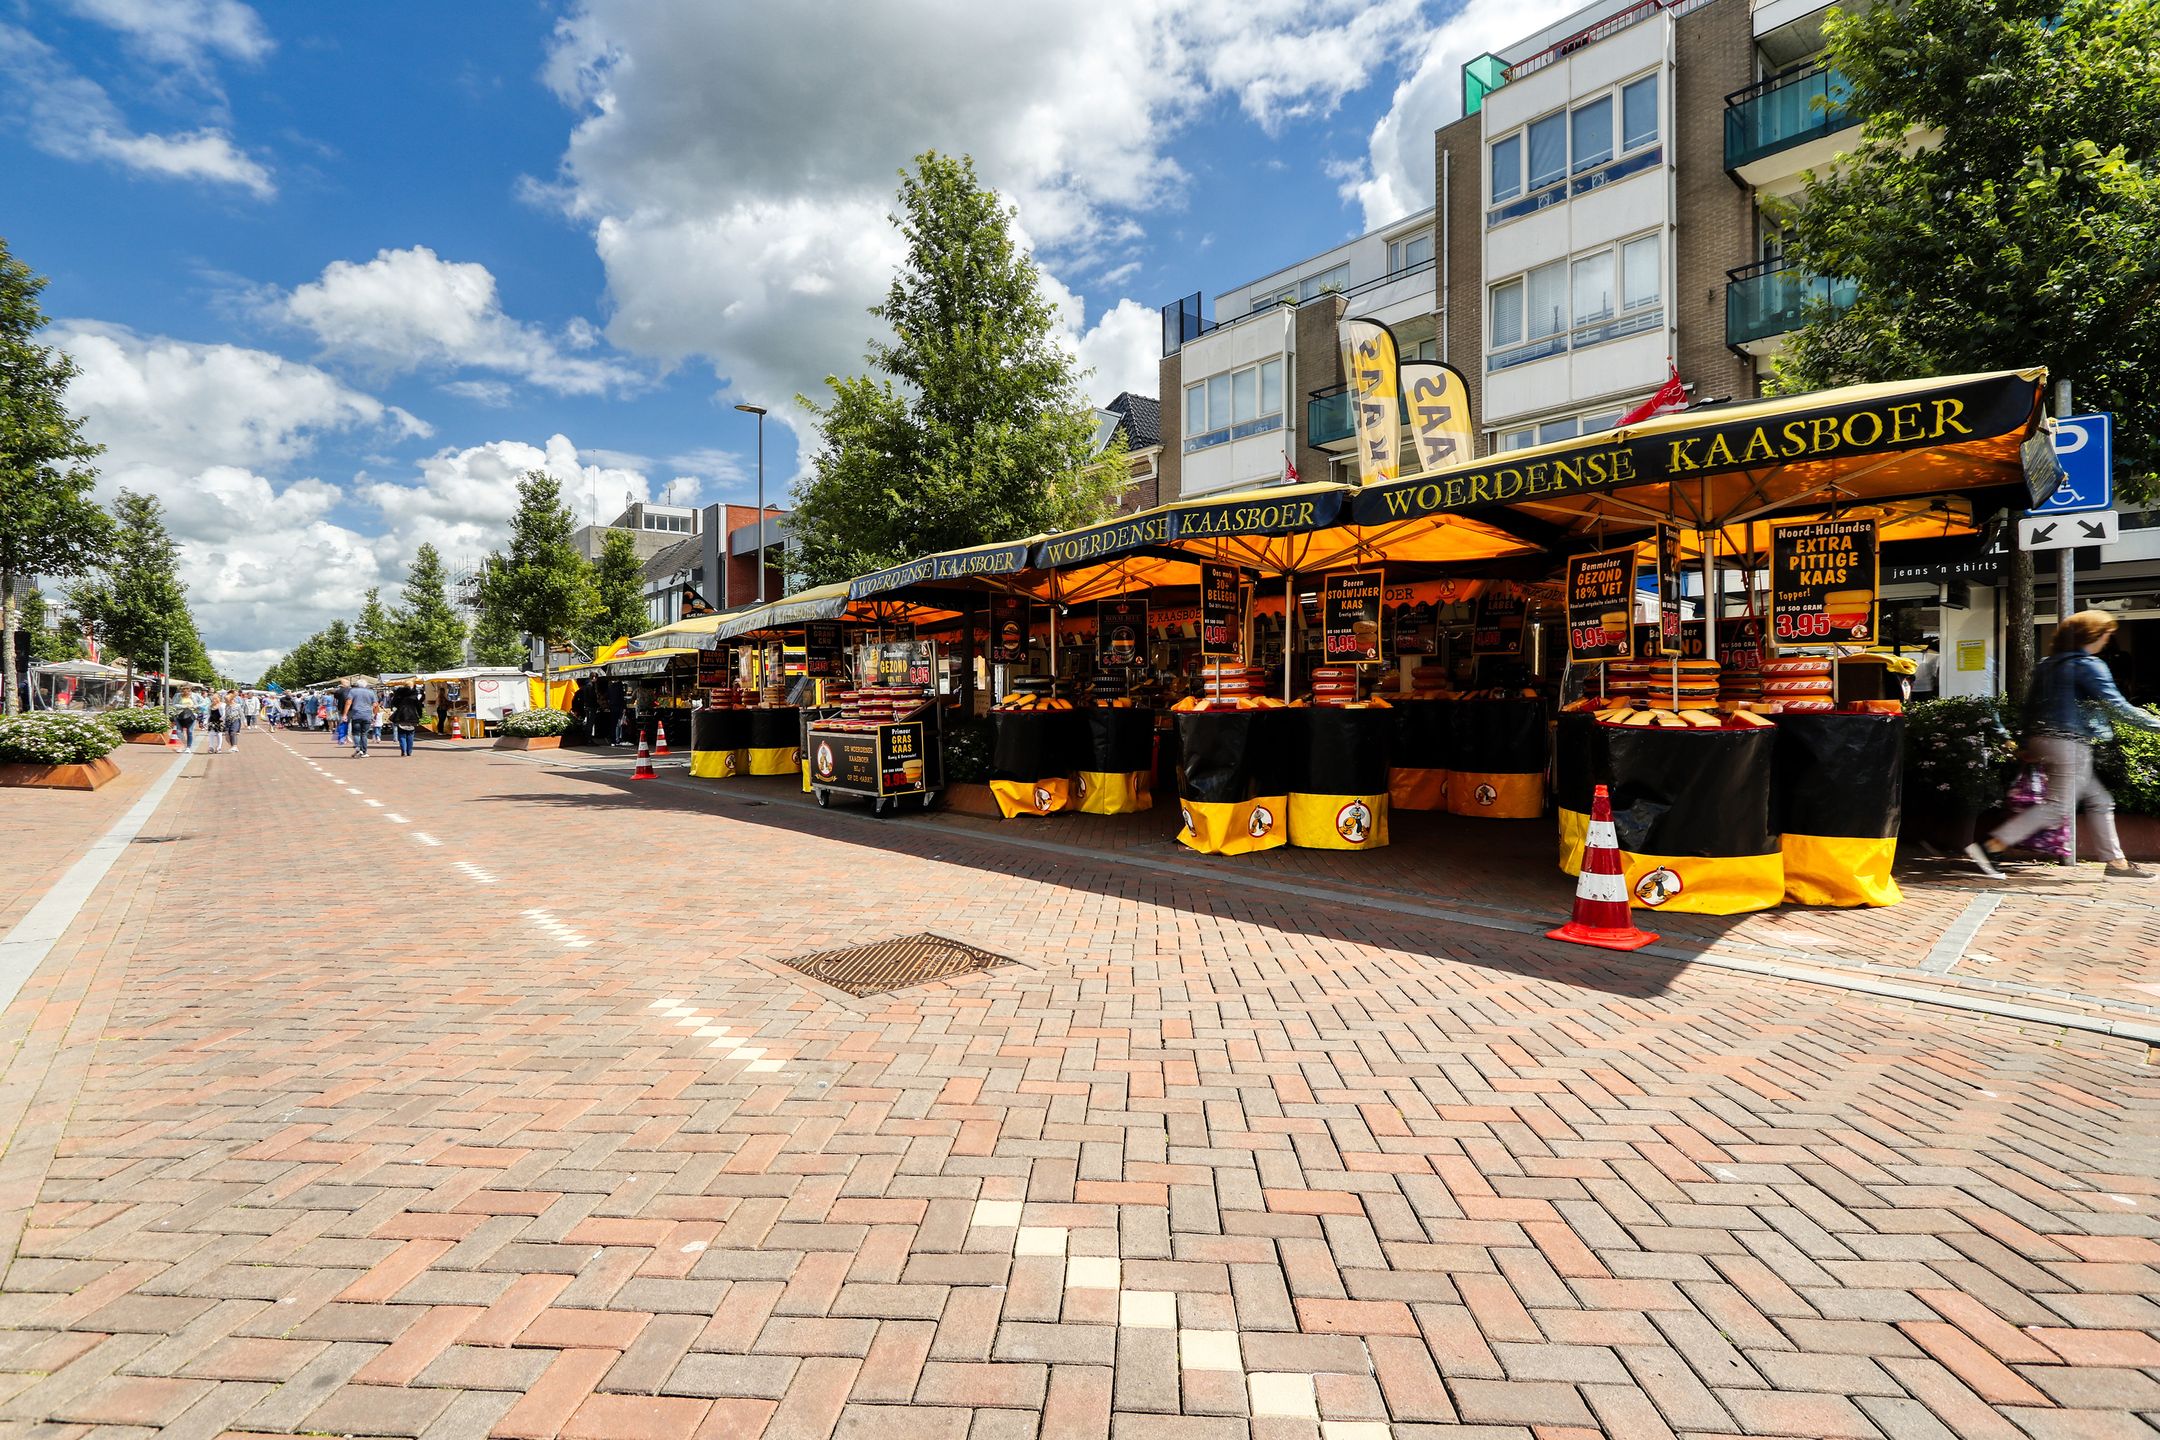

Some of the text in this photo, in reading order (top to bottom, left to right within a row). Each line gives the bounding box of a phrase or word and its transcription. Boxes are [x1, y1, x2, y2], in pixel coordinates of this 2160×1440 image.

[1382, 397, 1973, 517] WOERDENSE KAASBOER
[1047, 501, 1315, 565] WOERDENSE KAASBOER
[1778, 522, 1872, 539] Noord-Hollandse
[1795, 535, 1853, 554] EXTRA
[1789, 552, 1860, 571] PITTIGE
[1893, 567, 1929, 579] jeans
[1955, 560, 1998, 574] shirts
[858, 551, 1015, 596] WOERDENSE KAASBOER
[1577, 568, 1622, 586] GEZOND
[1799, 568, 1847, 586] KAAS
[1216, 578, 1230, 590] 30+
[1327, 586, 1380, 600] STOLWIJKER
[1575, 585, 1597, 600] 18%
[1601, 581, 1623, 596] VET
[1207, 588, 1237, 603] BELEGEN
[1778, 588, 1811, 602] Topper!
[1341, 599, 1364, 610] KAAS
[1787, 604, 1801, 612] 500
[1802, 604, 1823, 612] GRAM
[1158, 608, 1201, 623] KAASBOE
[1776, 612, 1831, 639] 3,95
[1204, 625, 1228, 645] 4,95
[1571, 626, 1607, 650] 6,95
[1327, 635, 1357, 654] 5,95
[879, 659, 908, 674] GEZOND
[909, 666, 930, 686] 6,95
[891, 735, 912, 745] GRAS
[892, 744, 913, 754] KAAS
